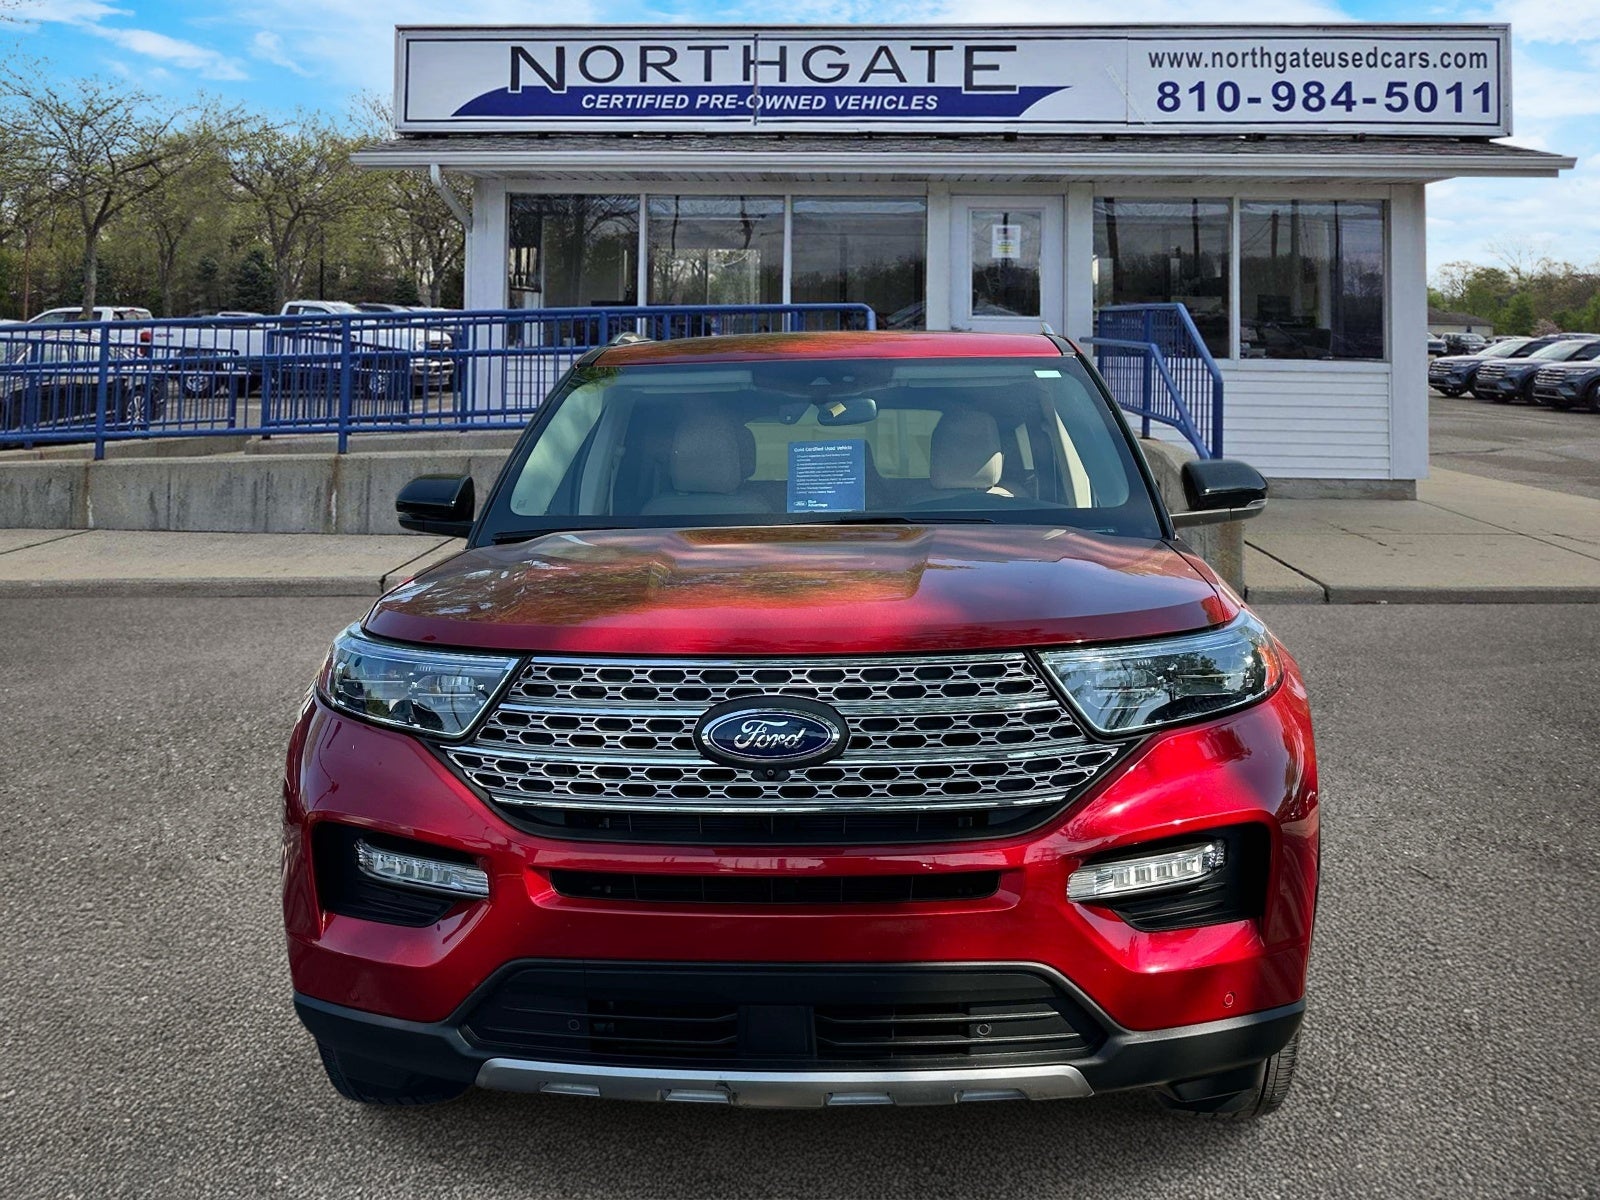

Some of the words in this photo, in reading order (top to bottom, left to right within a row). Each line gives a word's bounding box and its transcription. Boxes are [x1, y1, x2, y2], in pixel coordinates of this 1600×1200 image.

[509, 45, 1018, 92] NORTHGATE
[1148, 46, 1488, 74] www.northgateusedcars.com
[581, 93, 689, 110] CERTIFIED
[695, 94, 826, 110] PRE-OWNED
[834, 94, 938, 111] VEHICLES
[1156, 80, 1491, 113] 810-984-5011
[733, 719, 807, 750] Ford
